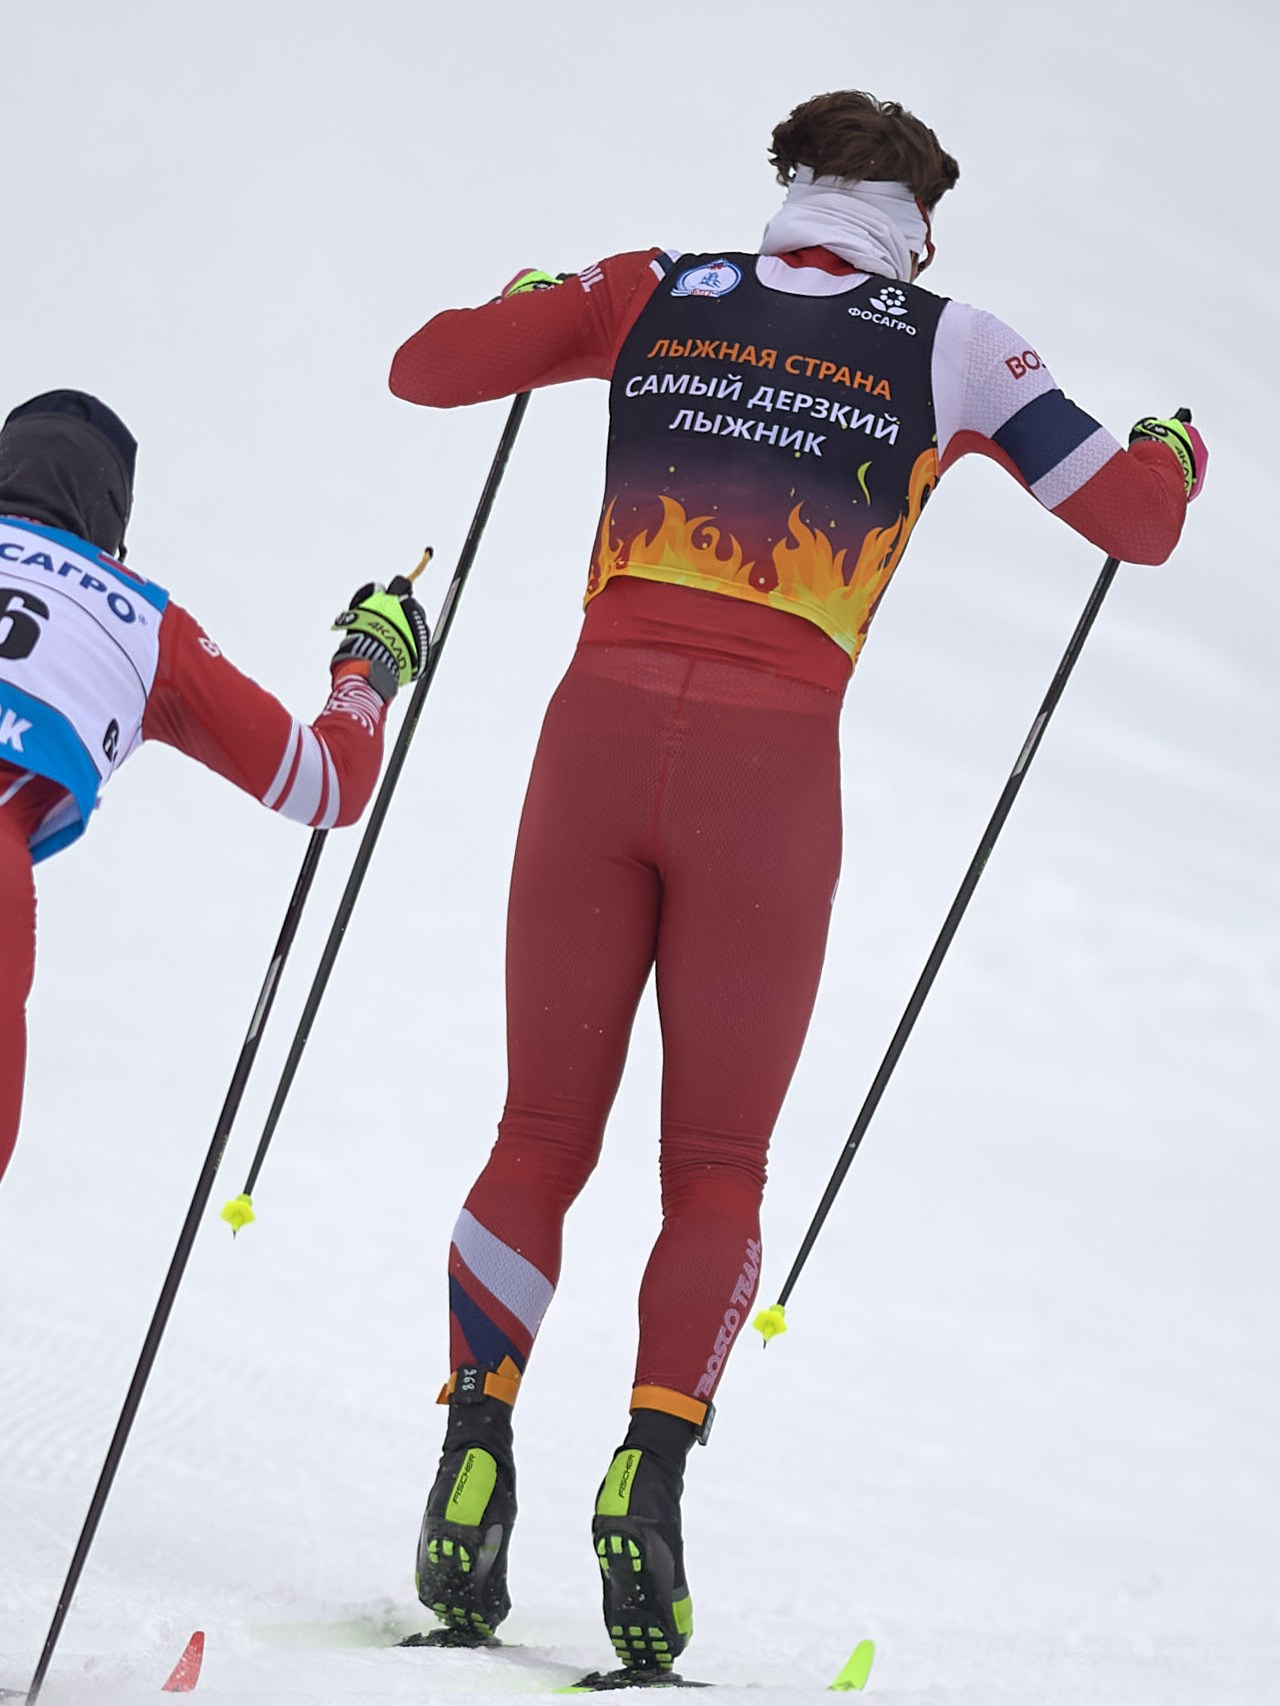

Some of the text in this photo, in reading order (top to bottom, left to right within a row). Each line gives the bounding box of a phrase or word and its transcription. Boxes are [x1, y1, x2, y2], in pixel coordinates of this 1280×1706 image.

[847, 307, 917, 336] ФОСАГРО
[647, 339, 891, 401] ЛЫЖНАЯ СТРАНА
[1005, 350, 1046, 380] BO
[625, 373, 901, 445] САМЫЙ ДЕРЗКИЙ
[669, 409, 827, 457] ЛЫЖНИК
[452, 1453, 476, 1505] FISCHER
[618, 1453, 635, 1499] FISCHER
